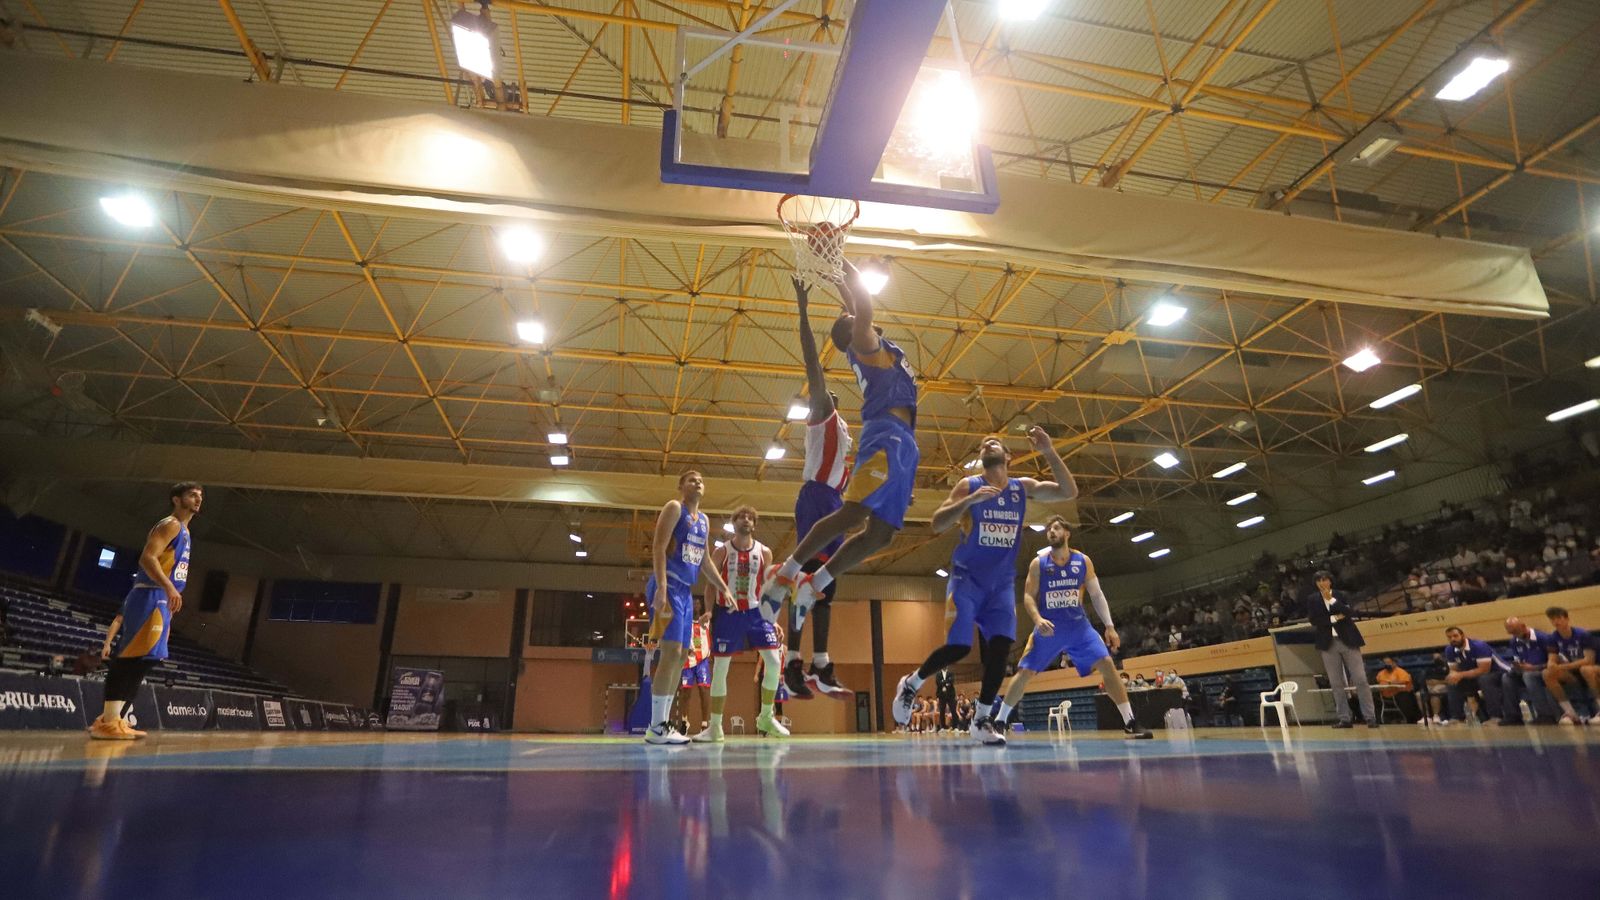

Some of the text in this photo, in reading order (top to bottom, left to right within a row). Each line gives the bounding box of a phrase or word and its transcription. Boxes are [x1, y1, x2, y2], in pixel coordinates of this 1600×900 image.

[998, 497, 1005, 506] 6
[993, 510, 1019, 520] MARBELLA
[982, 523, 1018, 534] TOYOT
